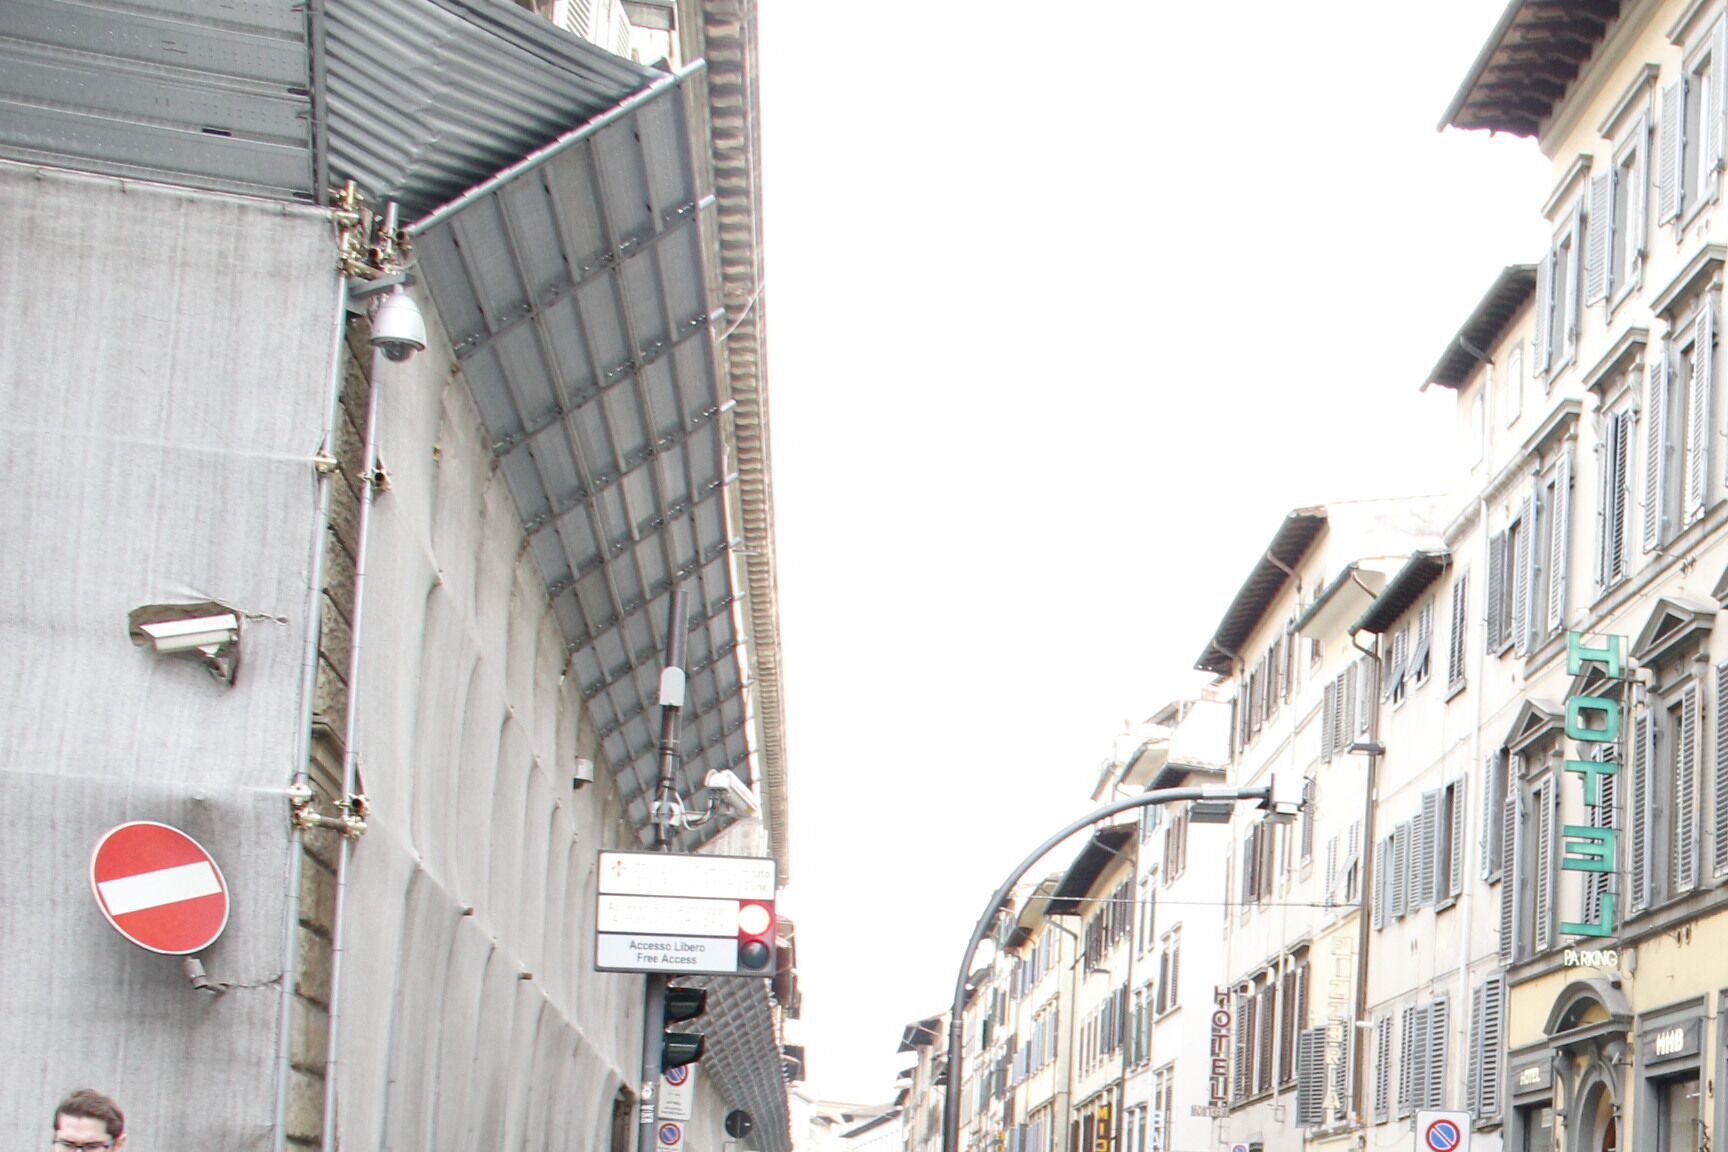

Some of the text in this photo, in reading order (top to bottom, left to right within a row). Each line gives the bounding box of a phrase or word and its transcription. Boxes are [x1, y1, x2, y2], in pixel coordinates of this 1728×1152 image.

[630, 940, 706, 952] Accesso Libero
[637, 952, 697, 965] Free Access
[1563, 949, 1618, 967] PARKING
[1210, 985, 1231, 1102] HOTEL
